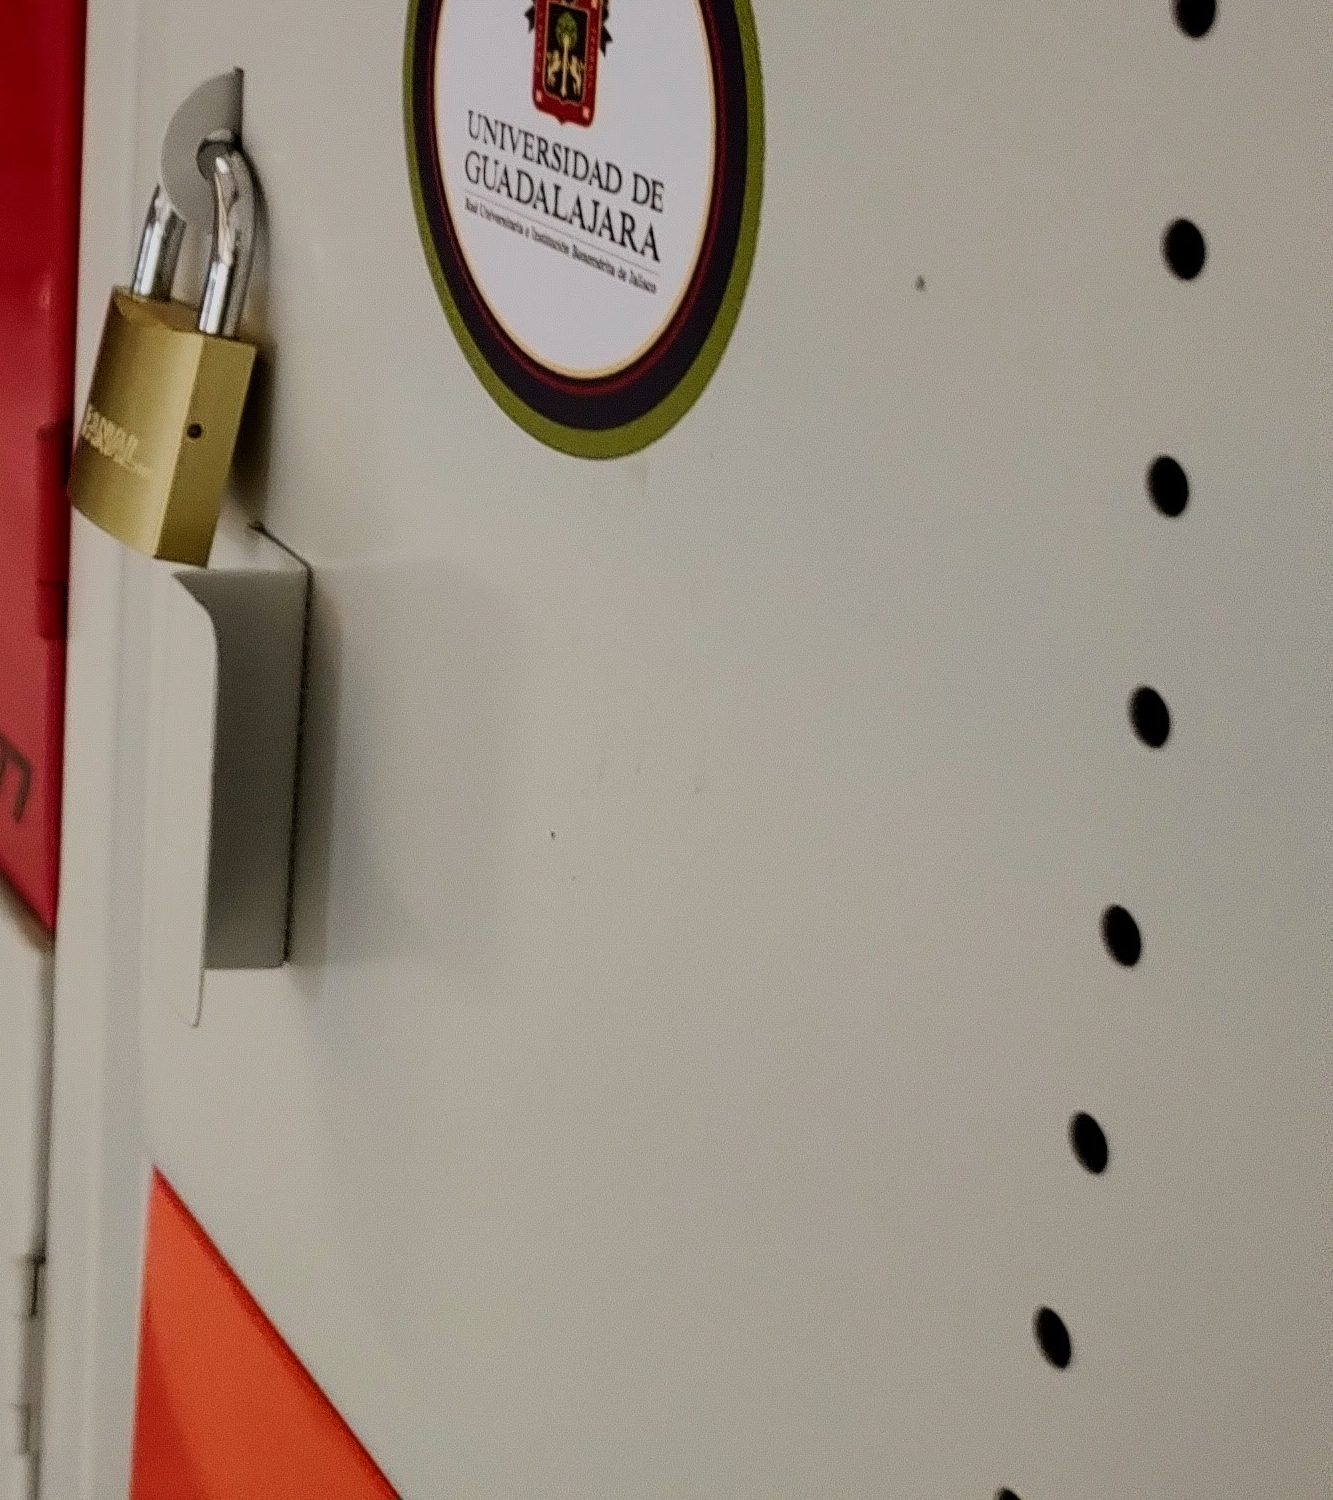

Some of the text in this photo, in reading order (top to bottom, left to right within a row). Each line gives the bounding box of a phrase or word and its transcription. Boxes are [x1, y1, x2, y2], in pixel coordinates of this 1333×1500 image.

[464, 150, 661, 263] GUADALAJARA
[467, 109, 665, 214] UNIVERSIDAD DE
[628, 269, 658, 296] Jalisco
